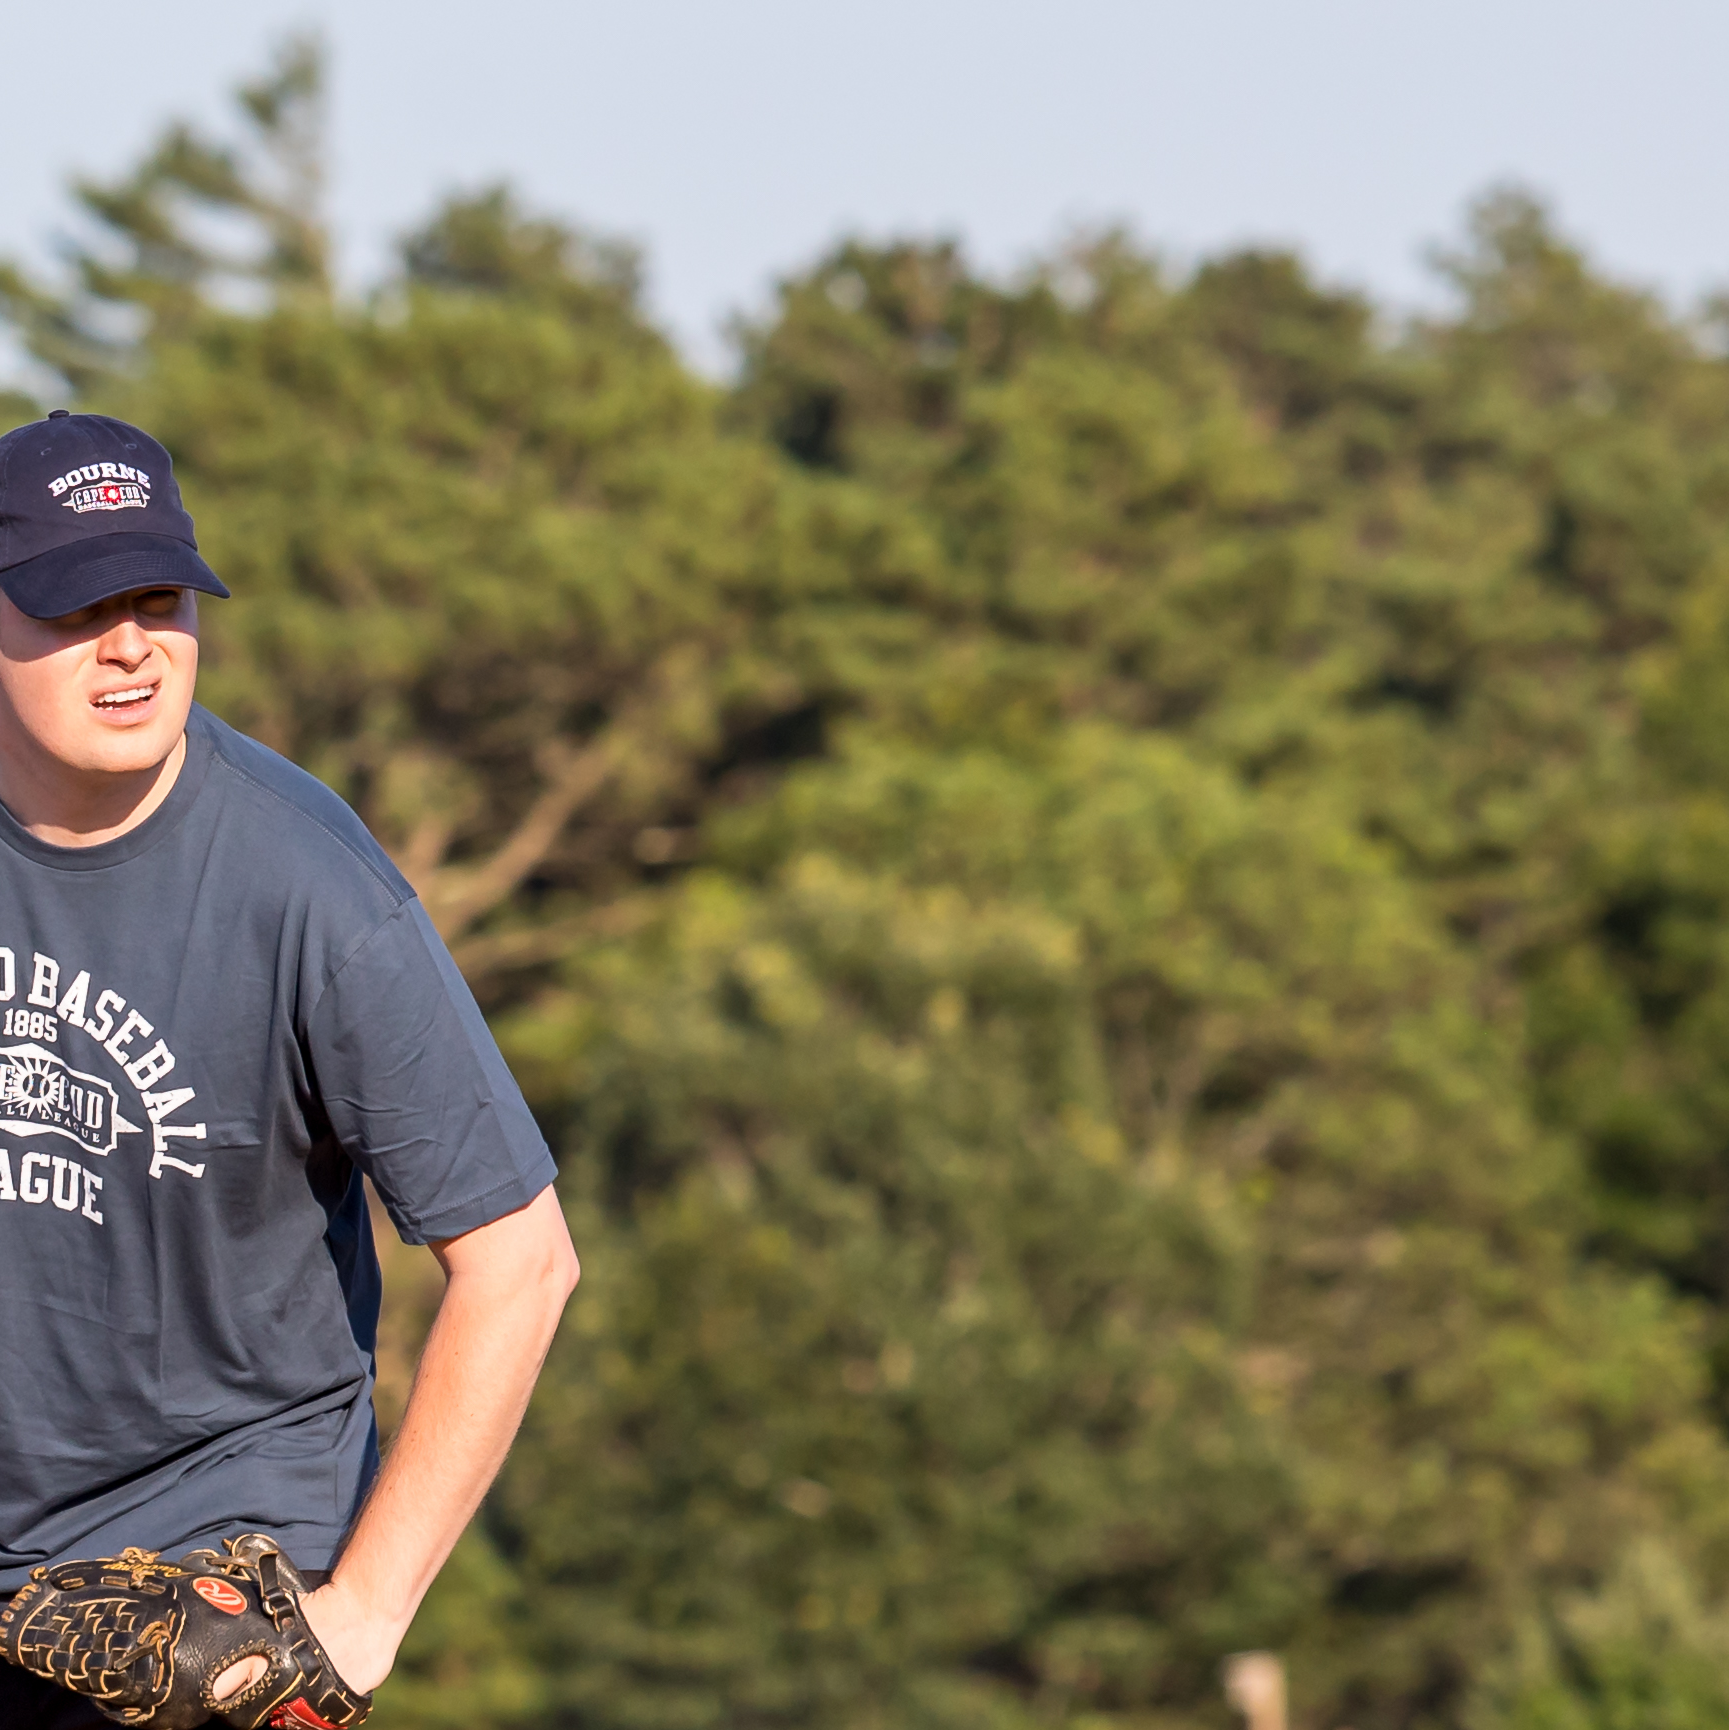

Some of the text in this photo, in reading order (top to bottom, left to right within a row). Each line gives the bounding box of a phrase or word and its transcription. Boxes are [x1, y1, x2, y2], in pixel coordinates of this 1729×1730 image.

[48, 462, 151, 497] BOURNE
[75, 486, 141, 505] CAPE COD
[3, 1007, 58, 1043] 1885
[27, 952, 207, 1180] BASEBALL
[57, 1075, 104, 1129] COD
[41, 1109, 101, 1143] LEAGUE
